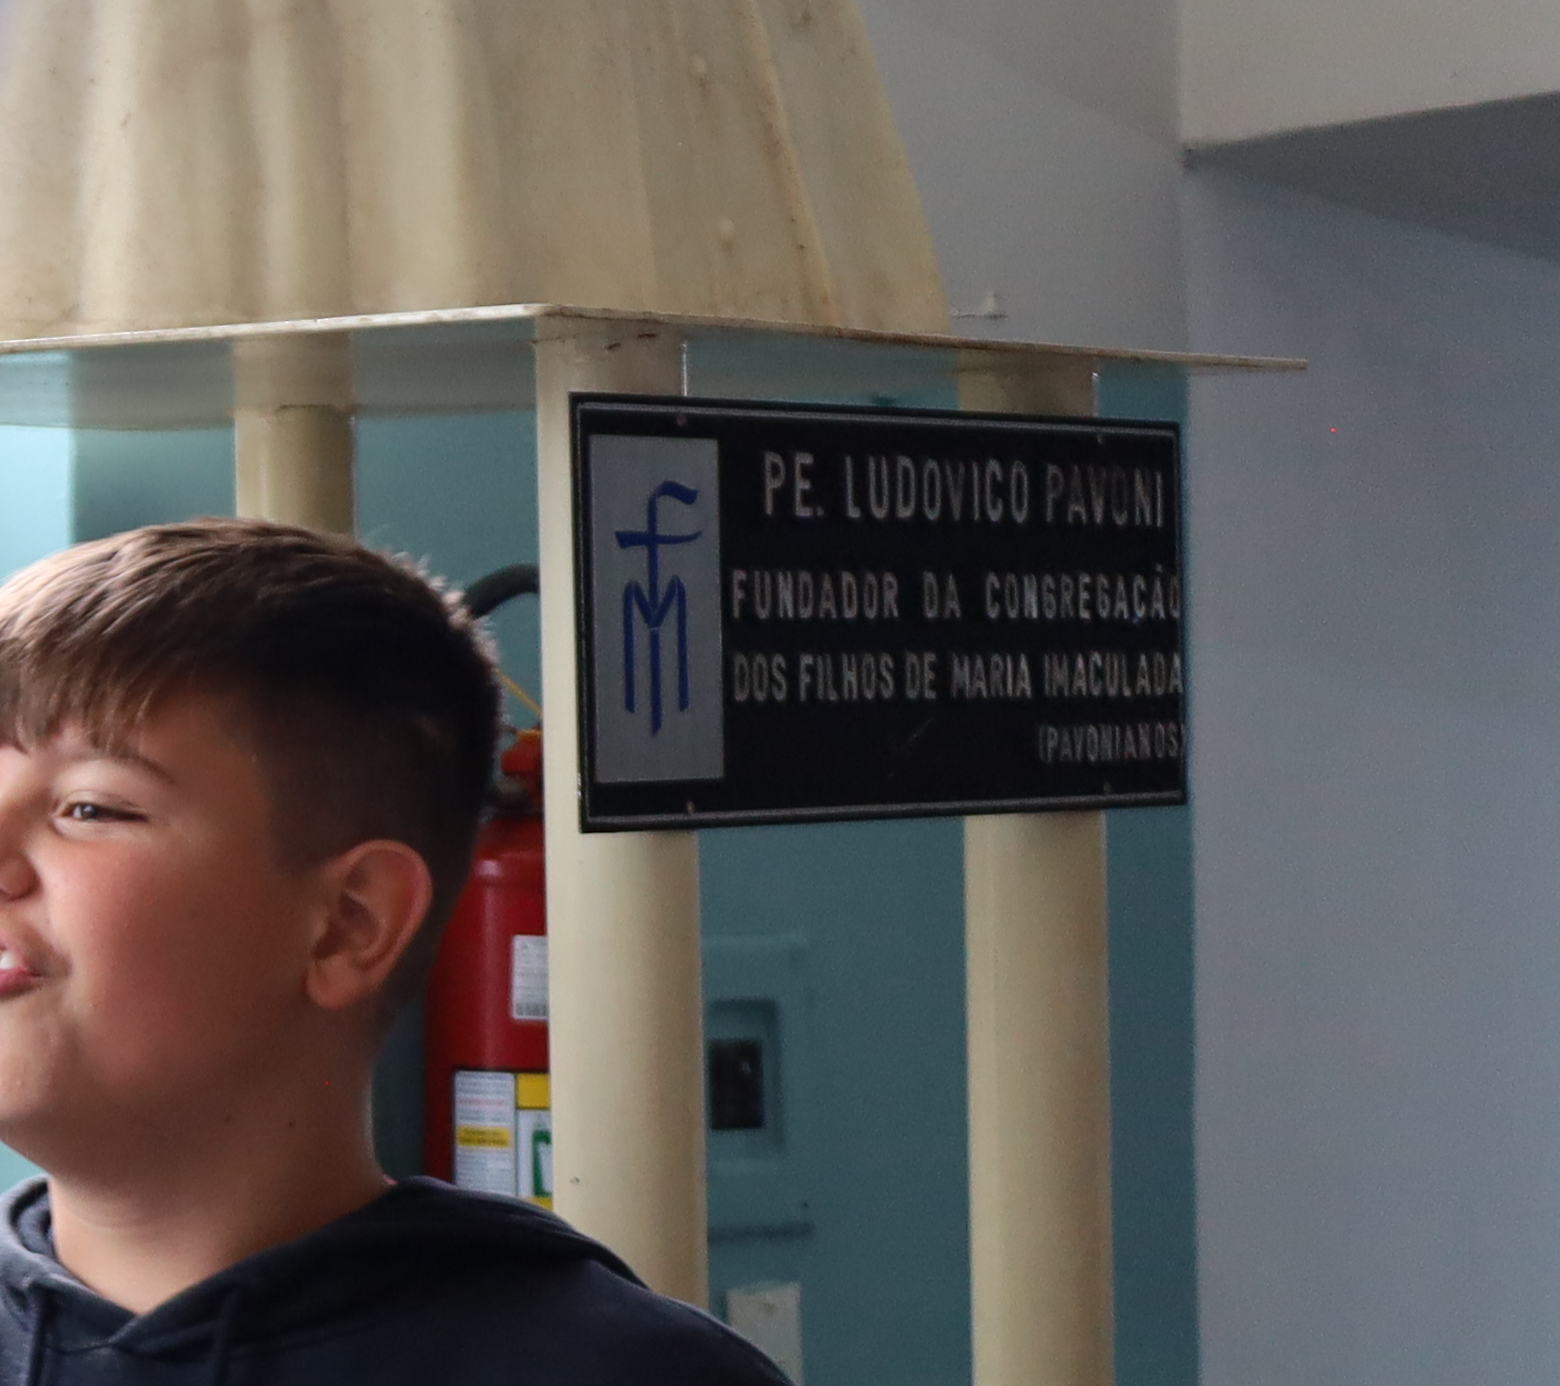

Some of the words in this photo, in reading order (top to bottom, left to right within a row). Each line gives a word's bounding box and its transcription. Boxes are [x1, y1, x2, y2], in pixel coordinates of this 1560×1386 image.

[763, 450, 825, 517] PE.
[844, 454, 1030, 523] LUDOVICO
[1045, 462, 1164, 527] PAVONI
[731, 568, 899, 619] FUNDADOR
[923, 570, 962, 620] DA
[733, 651, 789, 702] DOS
[798, 651, 896, 702] FILHOS
[905, 651, 938, 700] DE
[950, 651, 1033, 699] MARIA
[1043, 650, 1183, 699] IMACULADA
